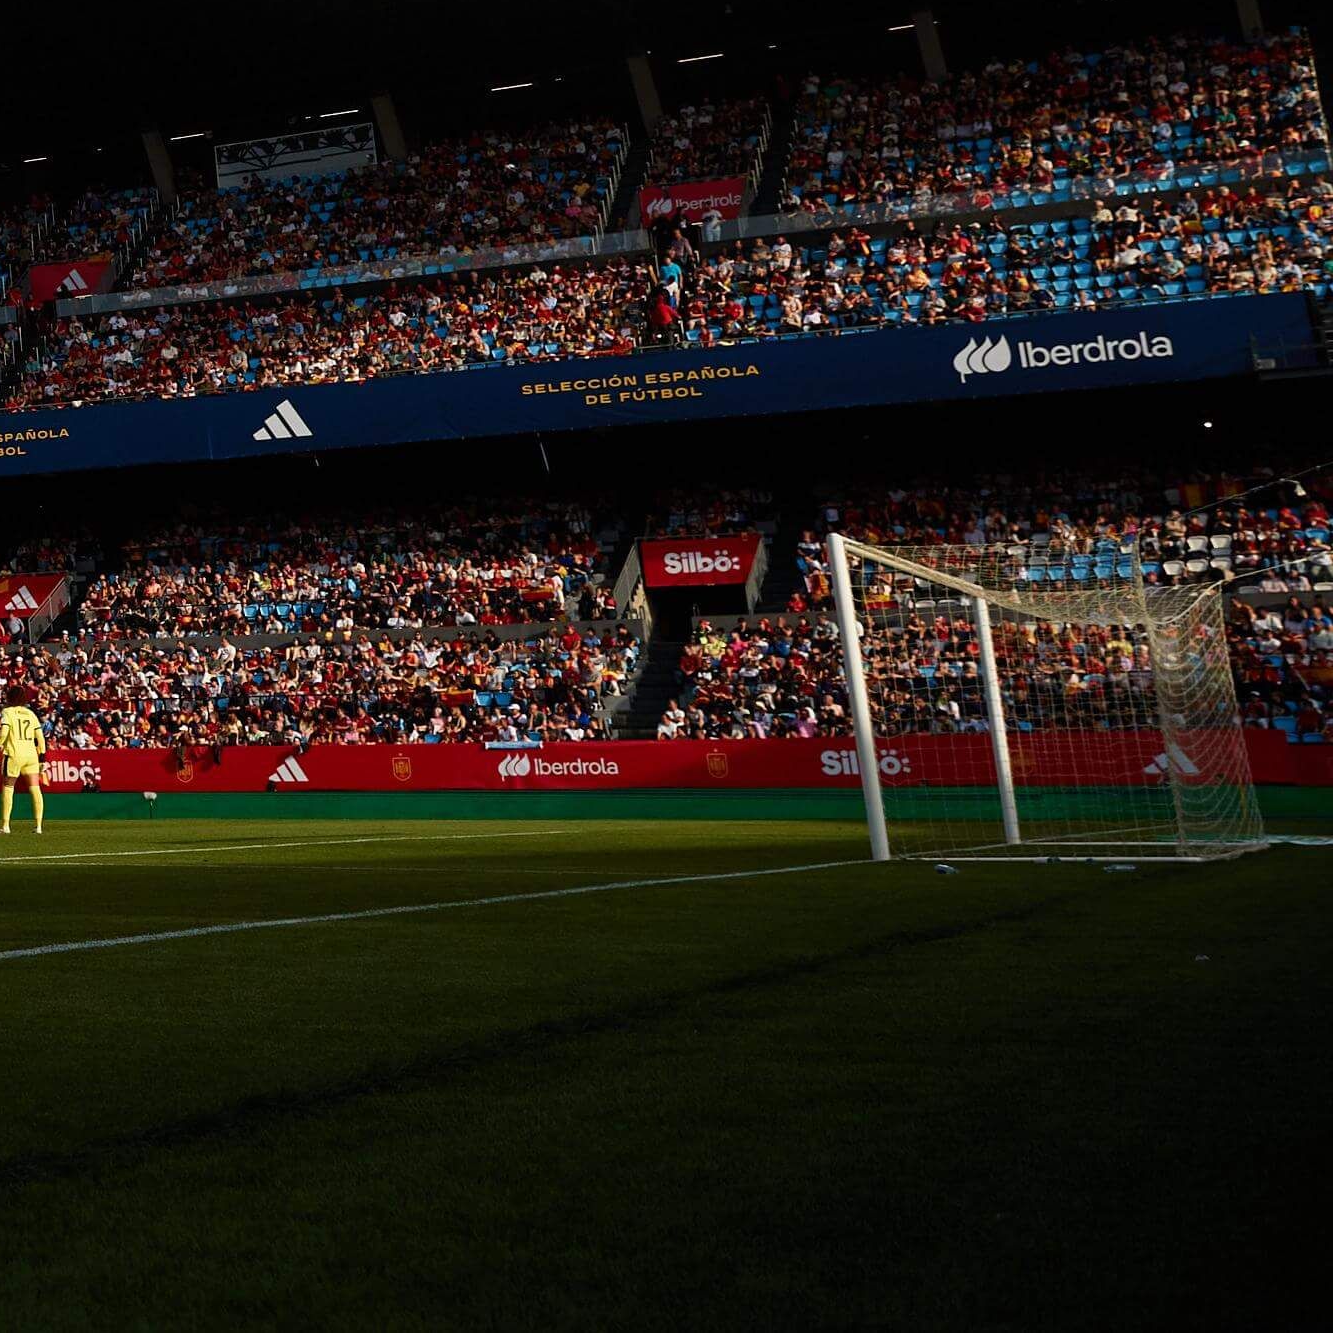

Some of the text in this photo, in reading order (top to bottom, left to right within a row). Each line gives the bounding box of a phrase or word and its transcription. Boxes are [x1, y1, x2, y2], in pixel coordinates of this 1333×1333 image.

[675, 192, 742, 211] Iberdrola
[1018, 330, 1174, 369] Iberdrola
[521, 364, 760, 395] SELECCIÓN ESPAÑOLA
[585, 385, 703, 406] DE FÚTBOL
[663, 549, 733, 575] Silbö
[17, 719, 33, 741] 12
[534, 757, 619, 775] Iberdrola
[820, 749, 902, 776] Silö
